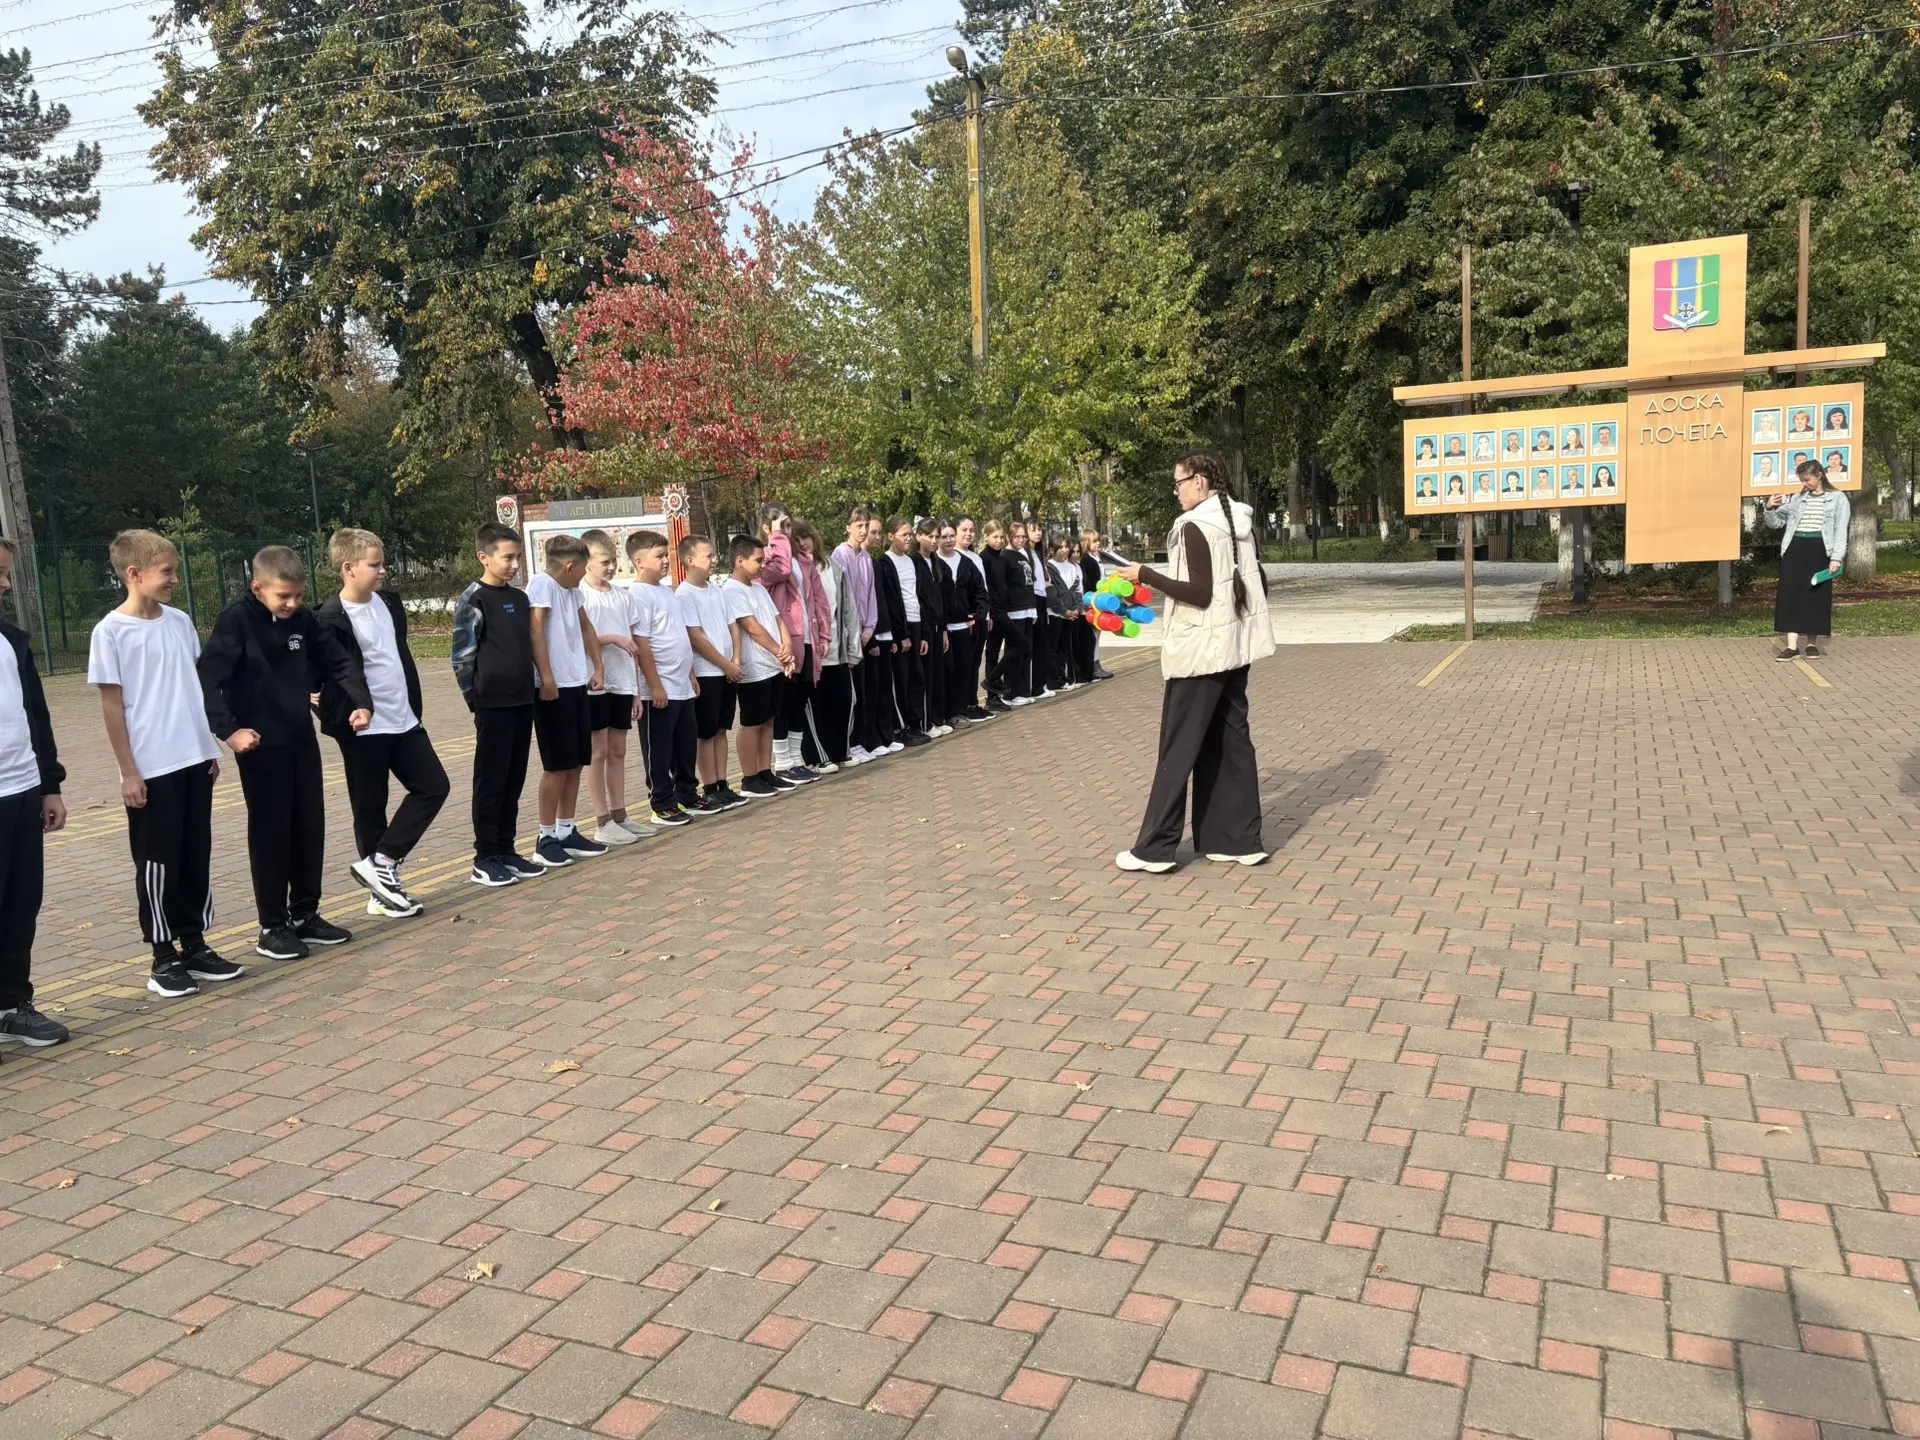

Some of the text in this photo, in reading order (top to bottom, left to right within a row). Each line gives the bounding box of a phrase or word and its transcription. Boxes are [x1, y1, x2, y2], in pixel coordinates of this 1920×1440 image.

[1644, 392, 1725, 416] ДОСКА
[1639, 423, 1728, 446] ПОЧЕТА
[289, 640, 300, 650] 96
